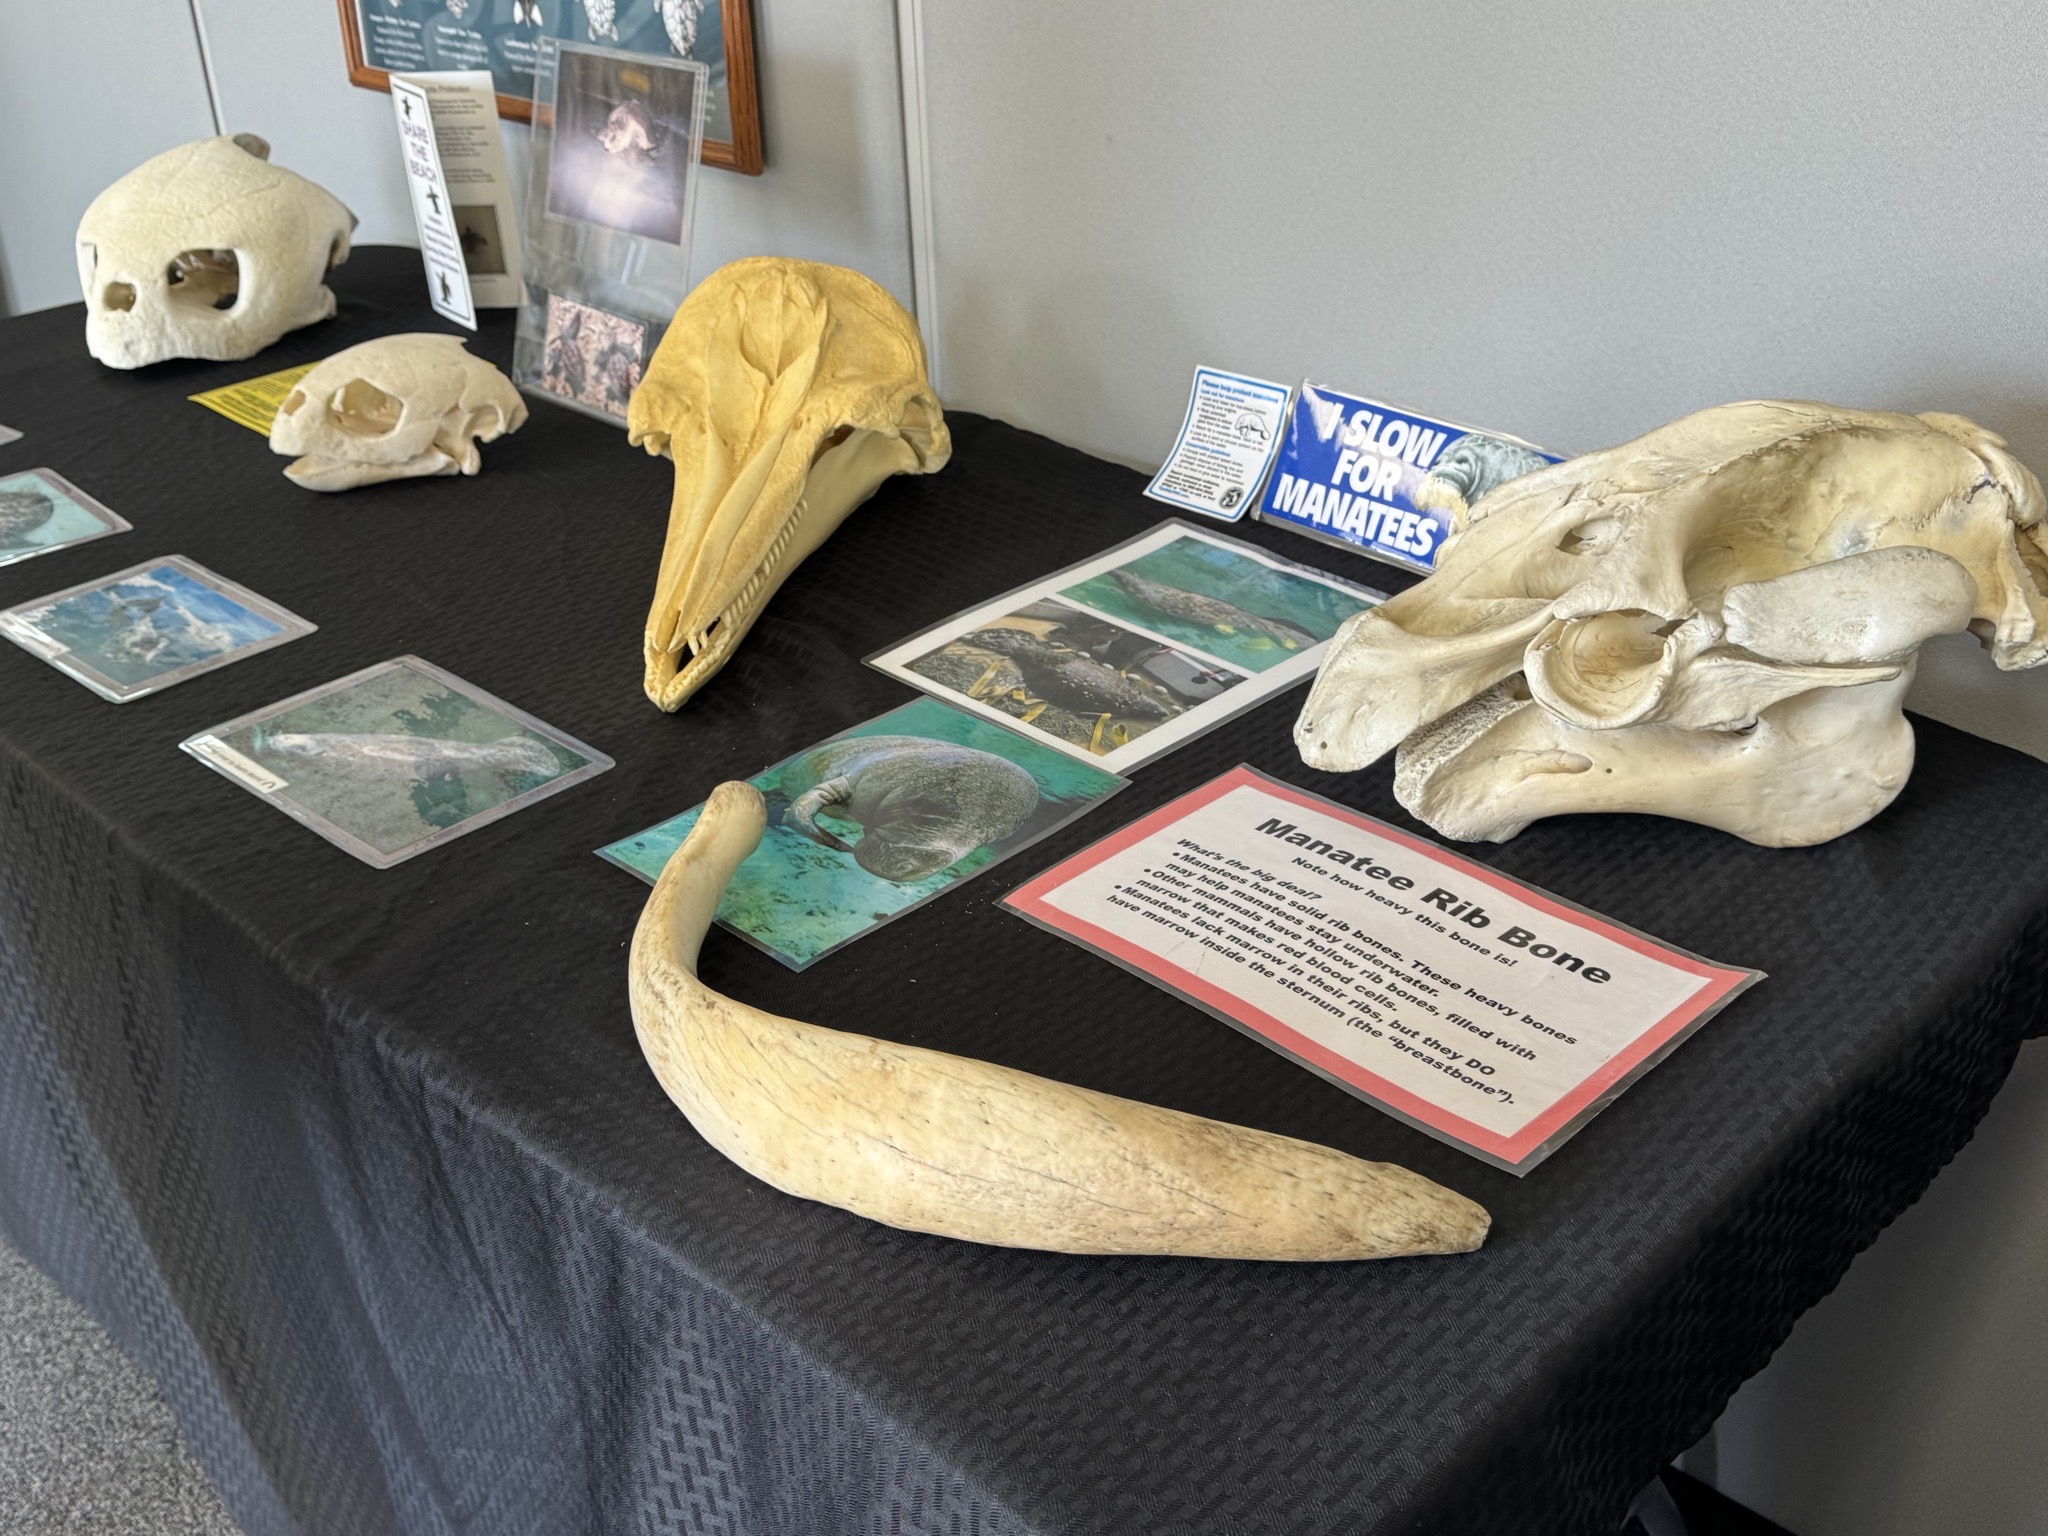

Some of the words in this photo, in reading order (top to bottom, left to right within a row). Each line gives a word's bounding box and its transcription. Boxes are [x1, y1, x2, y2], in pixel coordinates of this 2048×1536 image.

[1323, 402, 1344, 439] I
[1343, 410, 1448, 467] SLOW
[1331, 450, 1403, 502] FOR
[1272, 474, 1439, 557] MANATEES
[1134, 878, 1192, 904] marrow
[1191, 901, 1225, 919] that
[1223, 916, 1275, 944] makes
[1275, 942, 1308, 959] red
[1304, 955, 1355, 985] blood
[1353, 984, 1397, 1012] cells.
[1164, 862, 1198, 878] may
[1195, 873, 1230, 891] help
[1229, 888, 1305, 926] manatees
[1304, 924, 1343, 944] stay
[1342, 942, 1439, 998] underwater.
[1223, 858, 1251, 871] the
[1249, 868, 1277, 882] big
[1275, 880, 1323, 900] deal?
[1253, 817, 1415, 891] Manatee
[1419, 886, 1491, 929] Rib
[1496, 924, 1611, 984] Bone
[1290, 856, 1328, 876] Note
[1328, 872, 1365, 891] how
[1363, 888, 1414, 916] heavy
[1413, 913, 1447, 933] this
[1447, 930, 1491, 956] bone
[1492, 952, 1519, 967] is!
[1105, 893, 1141, 912] have
[1140, 909, 1200, 939] marrow
[1198, 935, 1246, 963] inside
[1247, 960, 1275, 978] the
[1275, 976, 1346, 1018] sternum
[1345, 1016, 1383, 1038] (the
[1120, 885, 1190, 919] Manatees
[1189, 915, 1226, 936] lack
[1224, 933, 1287, 966] marrow
[1286, 963, 1305, 976] in
[1305, 974, 1348, 999] their
[1346, 998, 1384, 1023] ribs,
[1387, 1018, 1420, 1039] but
[1421, 1036, 1464, 1061] they
[1464, 1057, 1496, 1076] DO
[1150, 870, 1193, 889] Other
[1190, 886, 1264, 922] mammals
[1263, 918, 1302, 941] have
[1302, 937, 1359, 969] hollow
[1358, 968, 1384, 984] rib
[1383, 981, 1440, 1017] bones,
[1444, 1012, 1495, 1040] filled
[1494, 1037, 1537, 1061] with
[1178, 853, 1249, 885] Manatees
[1248, 880, 1286, 902] have
[1286, 899, 1329, 920] solid
[1325, 918, 1350, 932] rib
[1350, 928, 1404, 962] bones.
[1410, 958, 1462, 990] These
[1463, 987, 1519, 1017] heavy
[1519, 1013, 1578, 1045] bones
